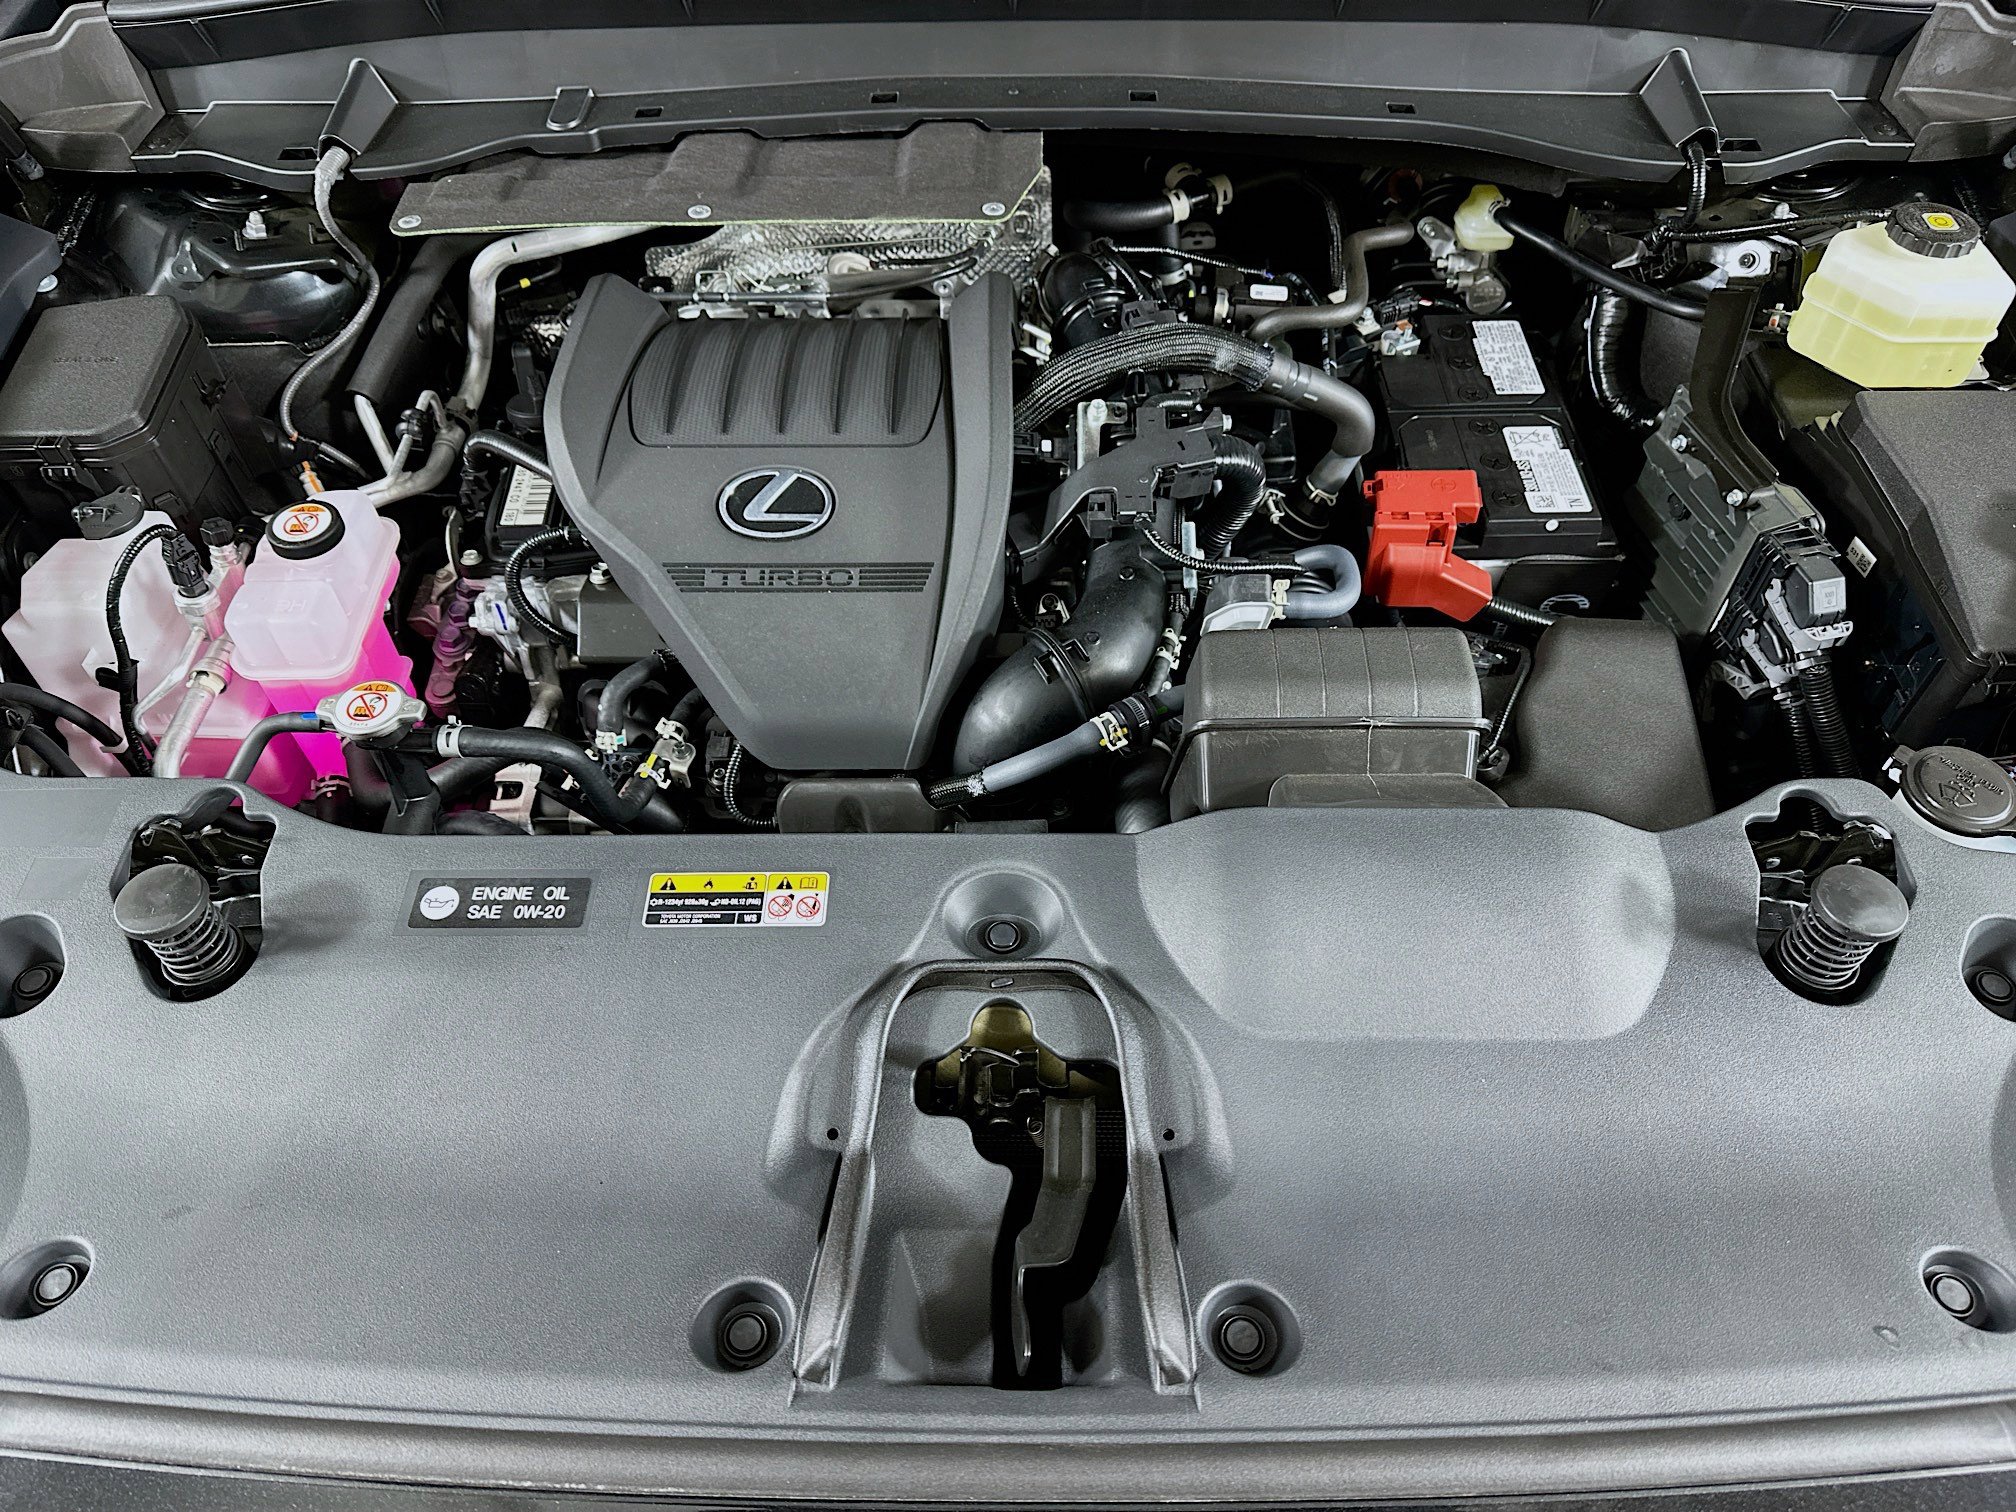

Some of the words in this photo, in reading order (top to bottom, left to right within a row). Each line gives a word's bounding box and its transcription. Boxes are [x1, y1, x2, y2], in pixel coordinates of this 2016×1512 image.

[710, 569, 855, 587] TURBO
[471, 886, 534, 900] ENGINE
[543, 886, 570, 901] OIL
[467, 905, 503, 919] SAE
[513, 905, 566, 919] 0W-20
[743, 914, 758, 922] WS
